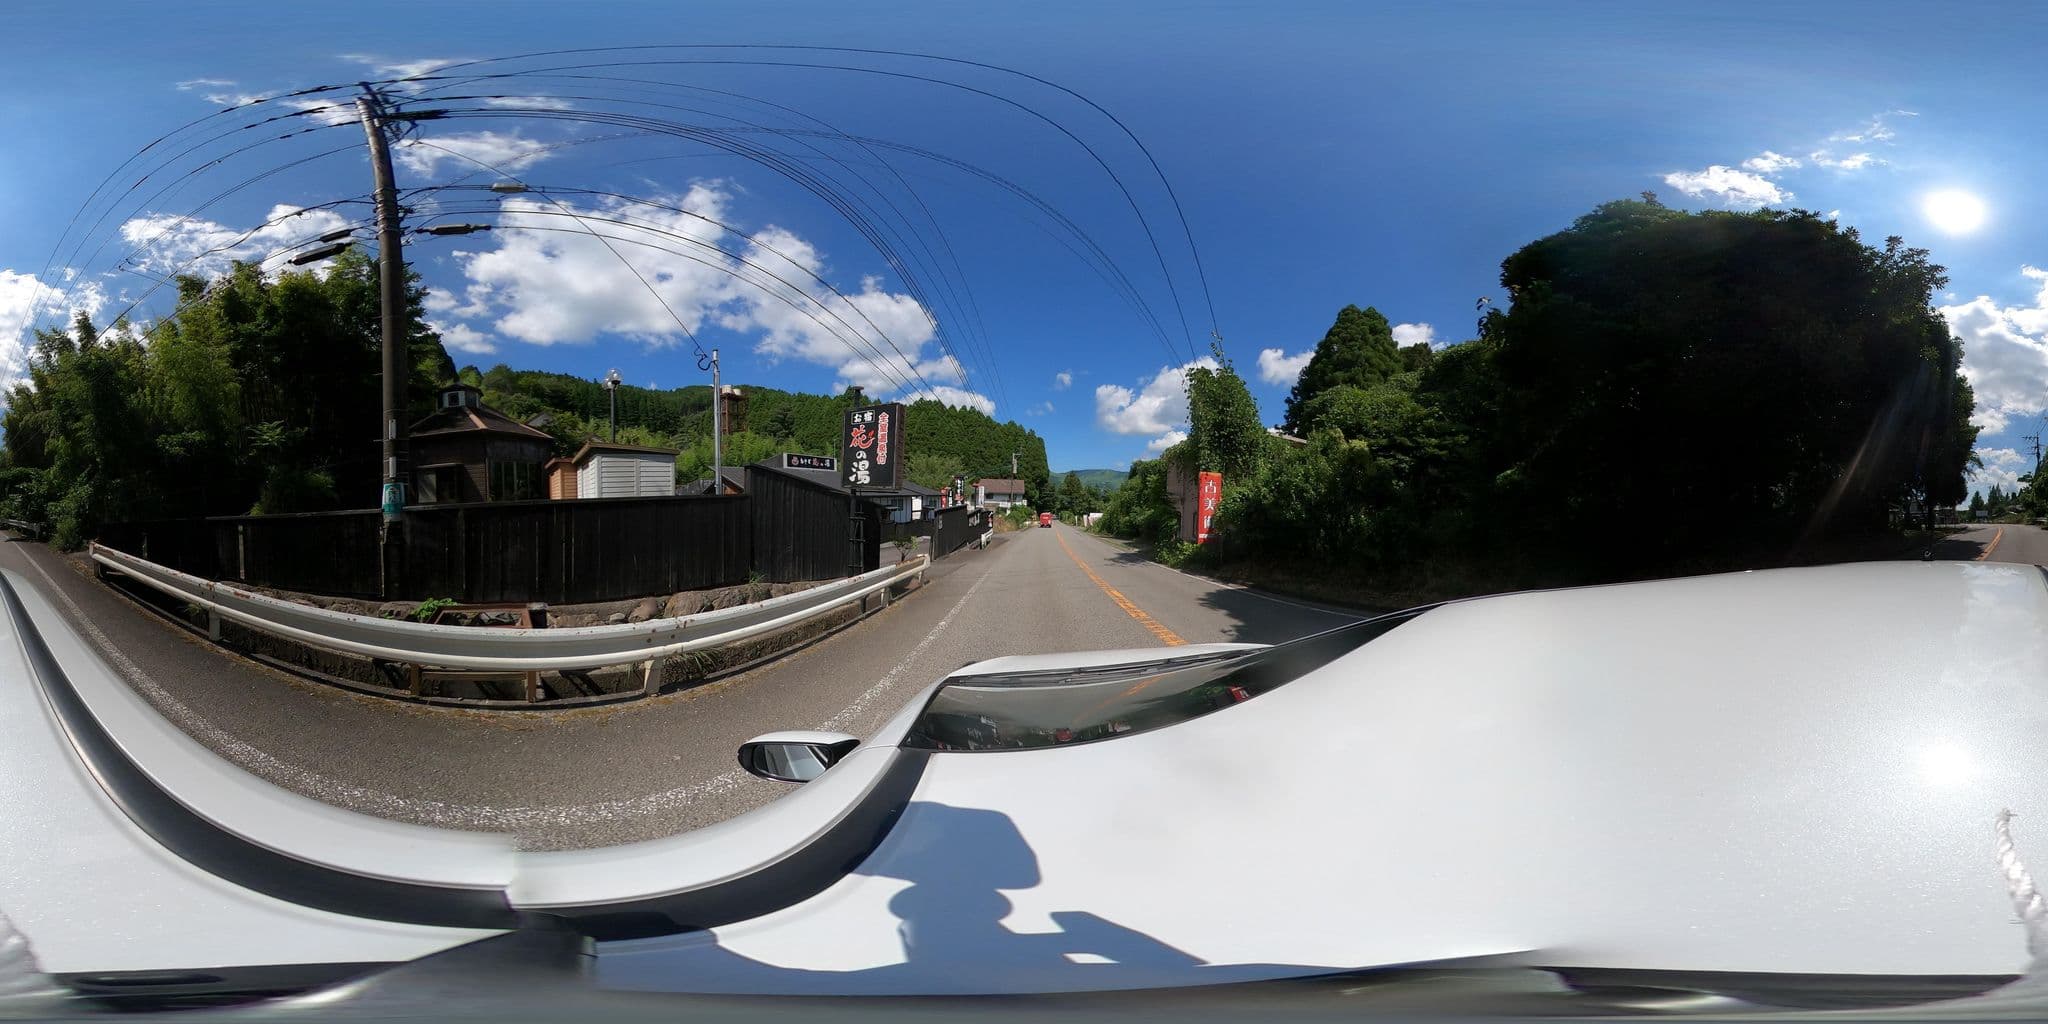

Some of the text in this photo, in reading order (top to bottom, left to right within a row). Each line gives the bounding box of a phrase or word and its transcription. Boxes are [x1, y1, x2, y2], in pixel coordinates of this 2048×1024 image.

[854, 411, 873, 423] お宿
[849, 424, 876, 485] 花の湯
